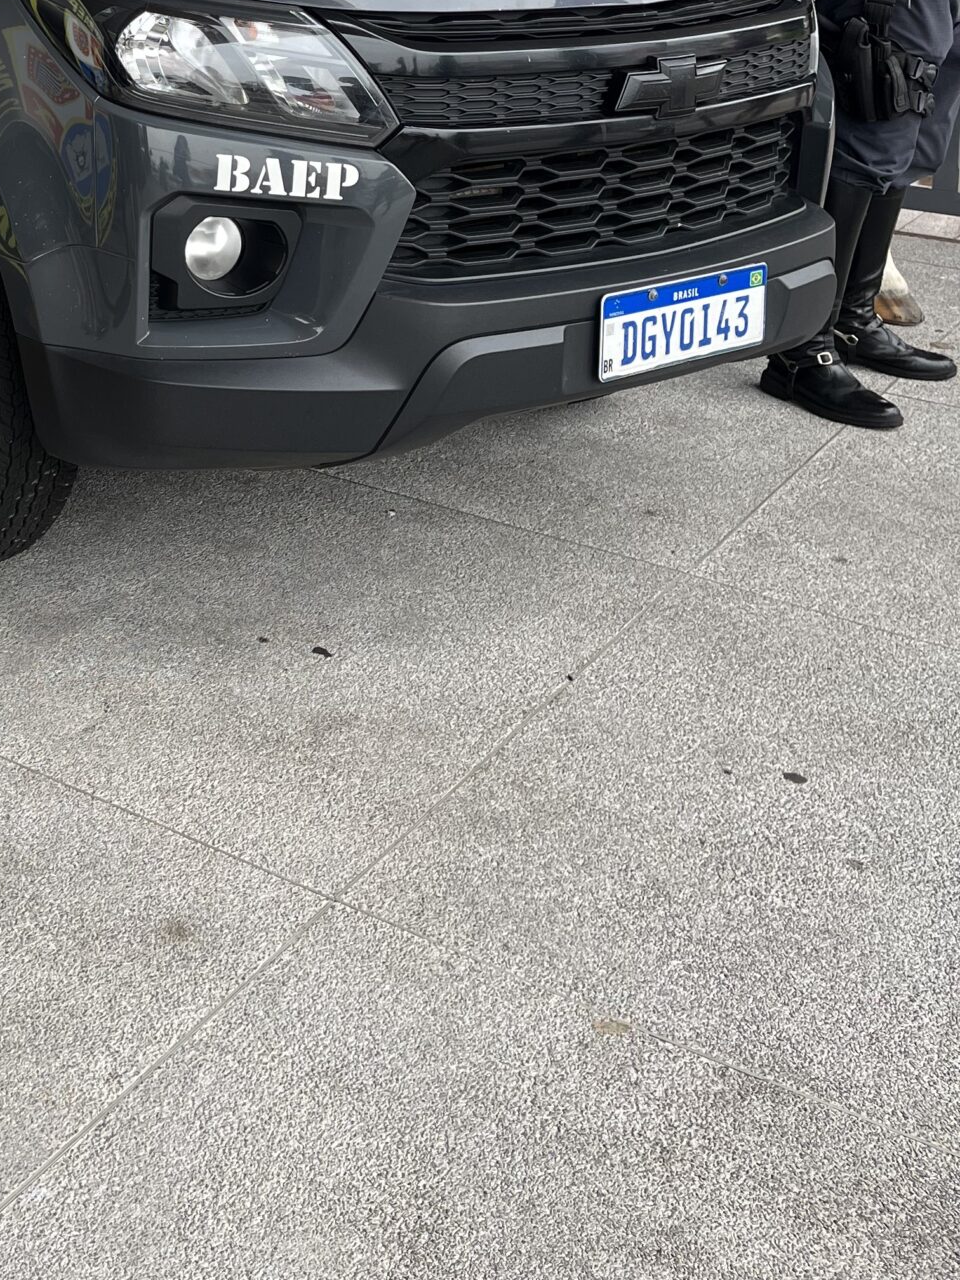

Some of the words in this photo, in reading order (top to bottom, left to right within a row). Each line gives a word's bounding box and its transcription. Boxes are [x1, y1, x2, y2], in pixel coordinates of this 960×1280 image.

[213, 153, 360, 200] BAEP
[673, 287, 700, 302] BRASIL
[603, 358, 614, 374] BR
